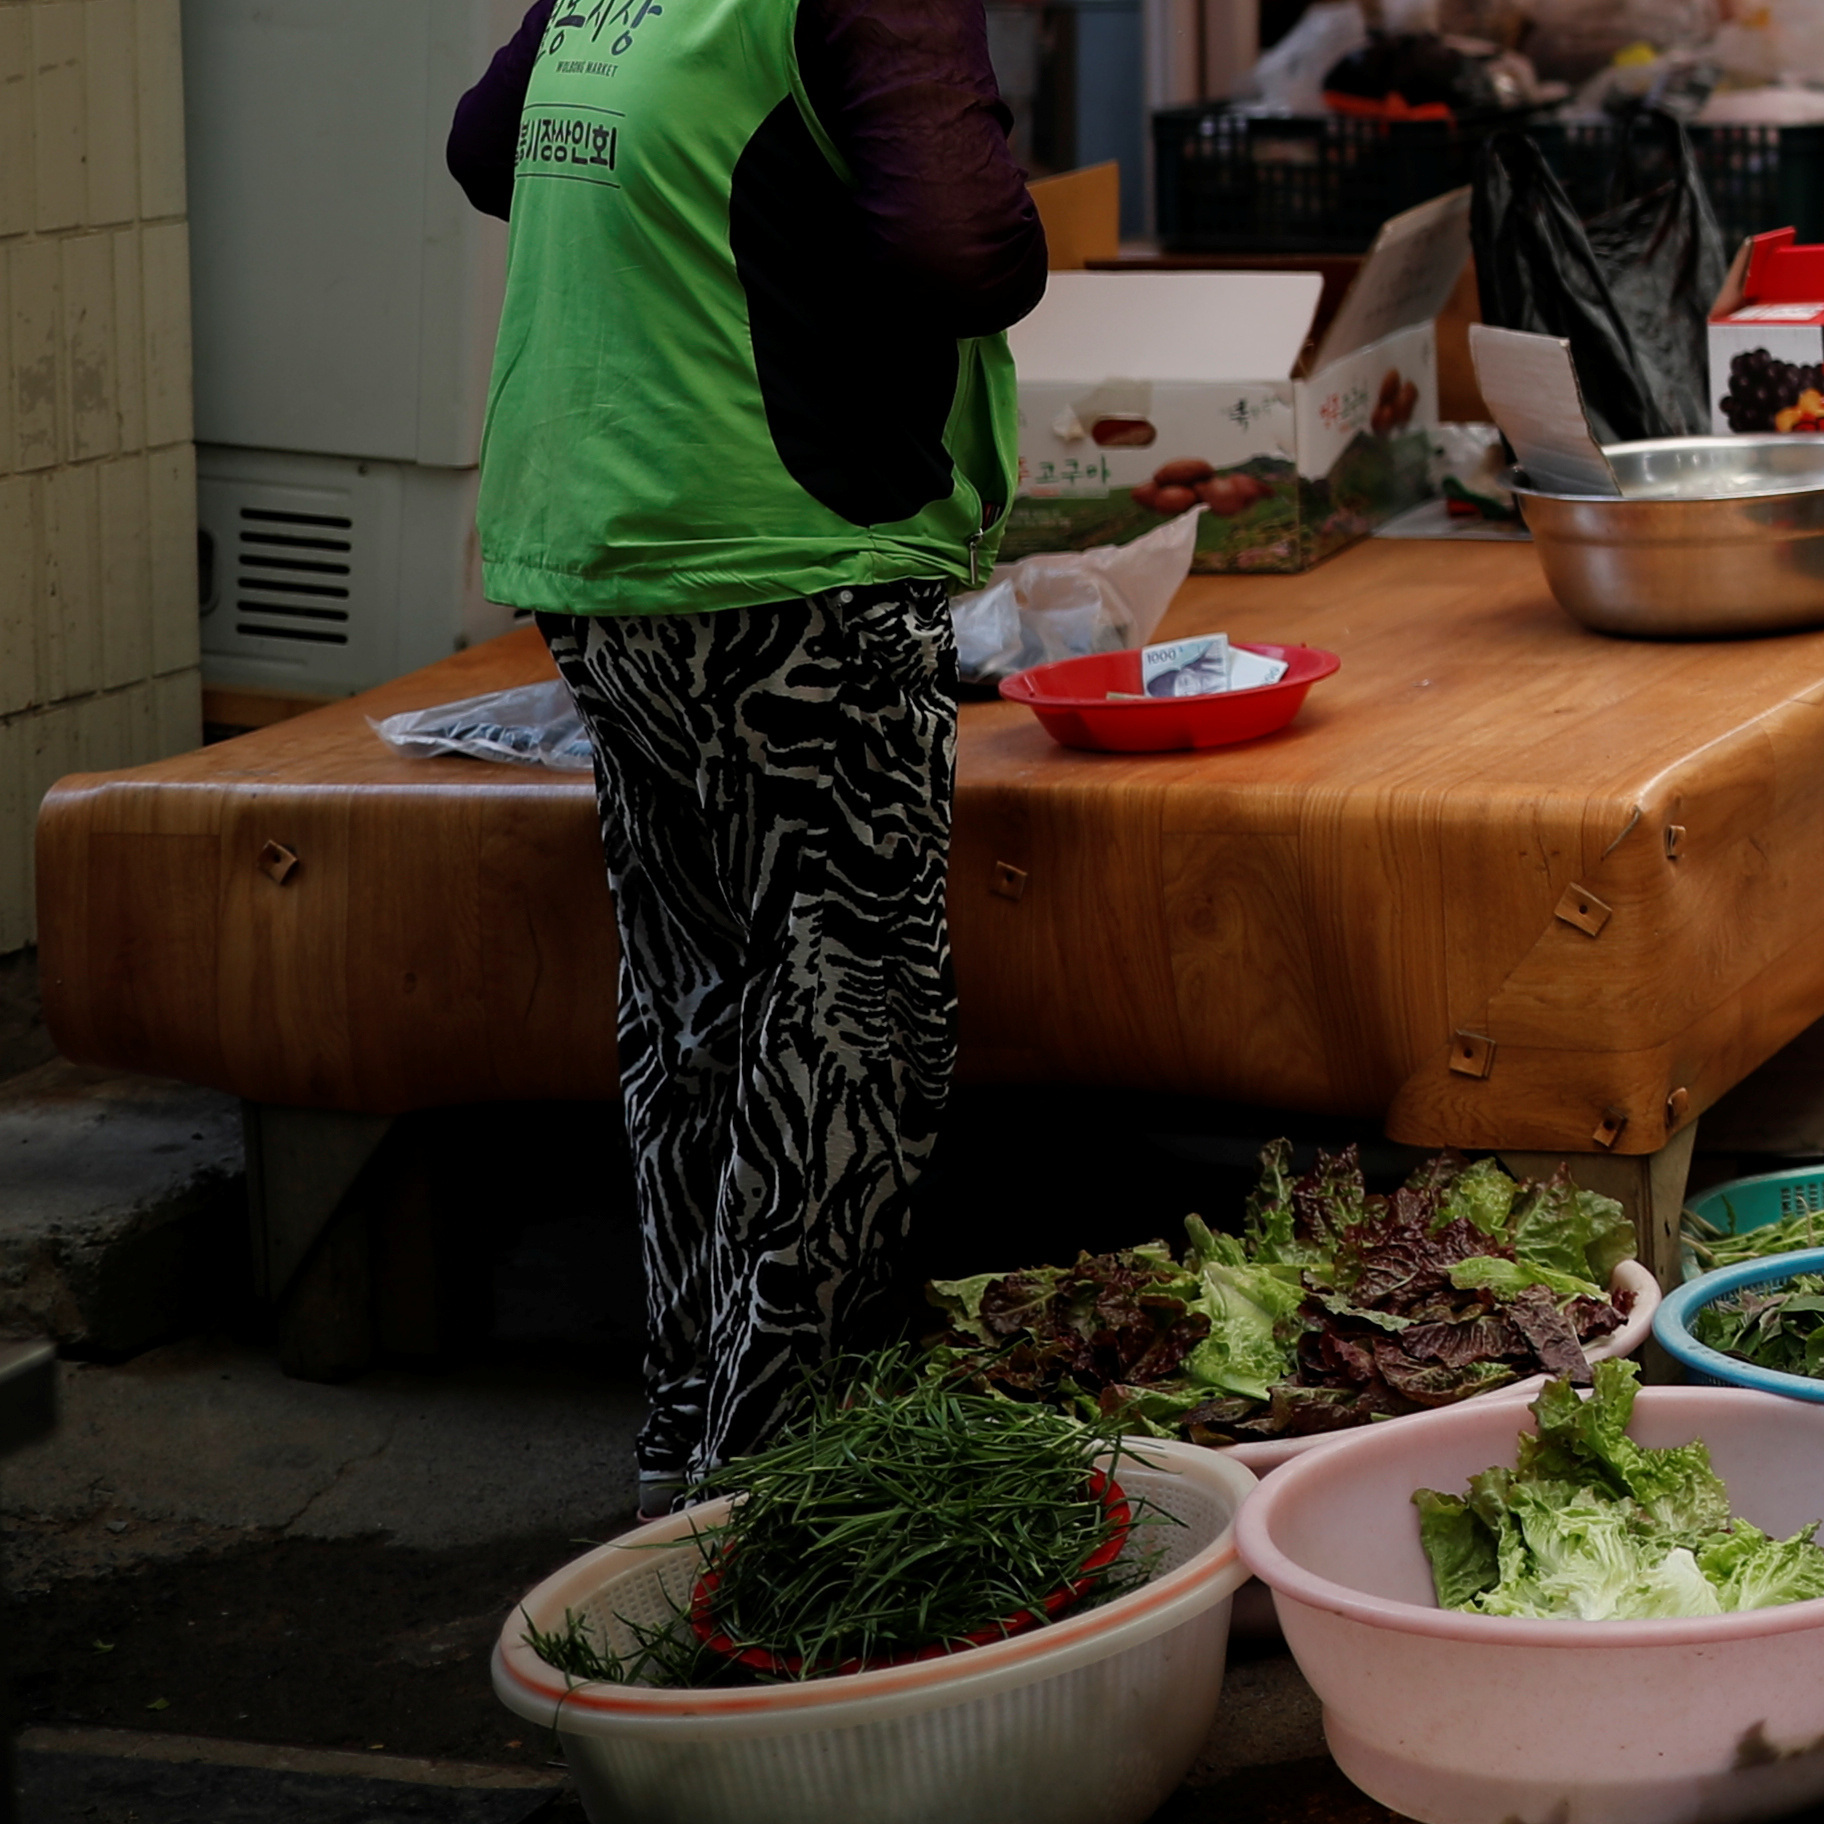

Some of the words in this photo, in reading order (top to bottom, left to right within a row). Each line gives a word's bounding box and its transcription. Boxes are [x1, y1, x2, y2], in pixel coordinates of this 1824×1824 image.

[555, 60, 585, 75] WOLBONG
[585, 61, 619, 77] MARKET
[1037, 455, 1112, 487] 고구마
[1146, 647, 1177, 665] 1000
